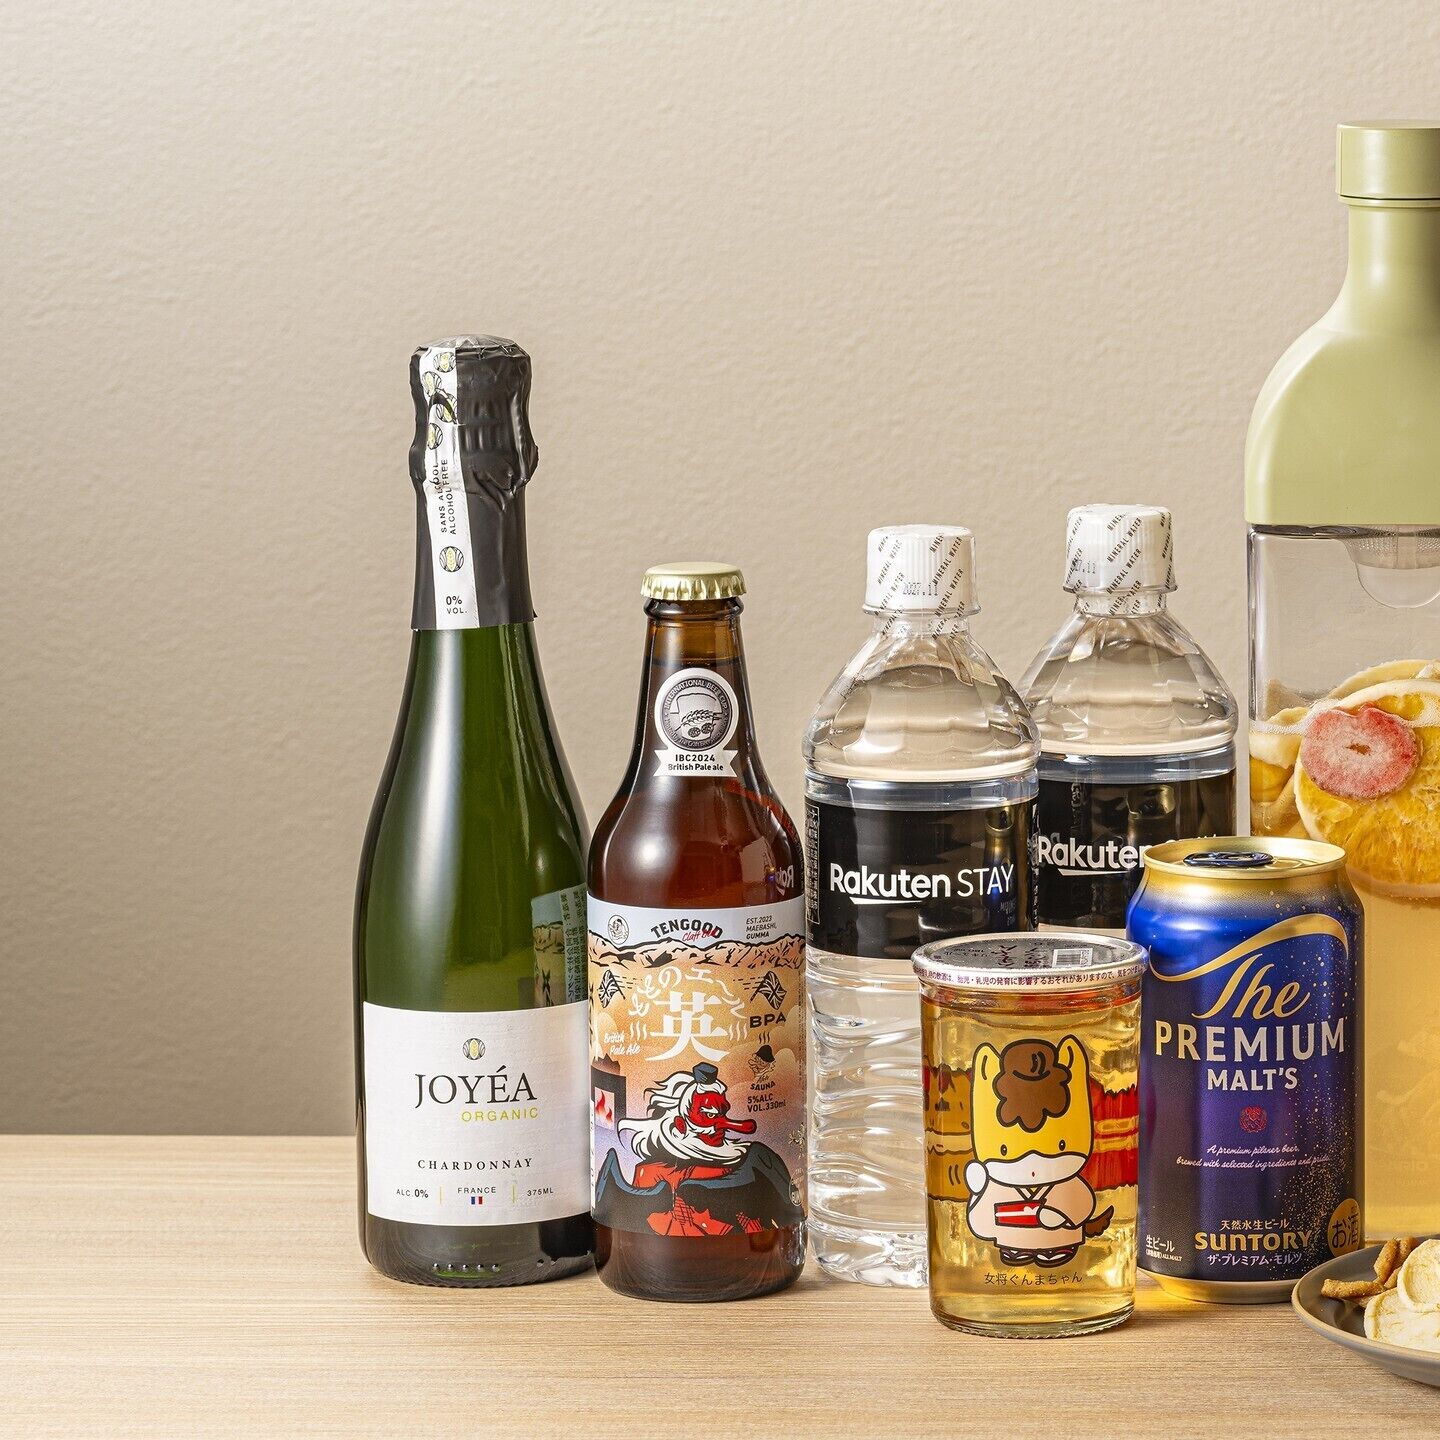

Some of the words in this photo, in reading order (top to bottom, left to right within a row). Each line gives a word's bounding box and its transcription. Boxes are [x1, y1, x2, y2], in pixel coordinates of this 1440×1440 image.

[441, 459, 449, 487] FREE
[438, 506, 447, 533] SANS
[1106, 537, 1129, 563] MINERAL
[1127, 516, 1142, 538] WATER
[932, 558, 951, 586] MINERAL
[949, 536, 962, 557] WATER
[1106, 568, 1129, 595] MINERAL
[1125, 547, 1142, 569] WATER
[445, 595, 462, 606] 0%
[934, 590, 953, 617] MINERAL
[949, 568, 964, 589] WATER
[664, 680, 705, 710] INTERNATIONAL
[675, 754, 715, 762] IBC2024
[695, 763, 711, 771] Pale
[829, 862, 951, 900] Rakuten
[957, 864, 1014, 897] STAY
[650, 919, 724, 940] TENGOOD
[746, 931, 770, 940] GUMMA
[645, 991, 730, 1062] 英
[750, 1011, 787, 1029] BPA
[1155, 1018, 1345, 1062] PREMIUM
[414, 1065, 538, 1108] JOYÉA
[750, 1081, 776, 1091] SAUNA
[1207, 1068, 1299, 1091] MALT'S
[461, 1107, 539, 1122] ORGANIC
[1207, 1144, 1217, 1153] A
[1216, 1147, 1251, 1156] premium
[1251, 1146, 1281, 1156] pilsner
[417, 1157, 533, 1170] CHARDONNAY
[1203, 1159, 1220, 1167] with
[1222, 1159, 1254, 1168] selected
[1255, 1158, 1296, 1171] ingredients
[1298, 1157, 1311, 1166] and
[527, 1187, 554, 1197] 375ML
[1221, 1219, 1289, 1231] 天然水生ビール
[1145, 1234, 1176, 1253] 生ビール
[1194, 1231, 1311, 1251] SUNTORY
[1207, 1253, 1301, 1266] ザ・プレミアム・モルツ
[984, 1272, 1083, 1285] 女将ぐんまちゃん
